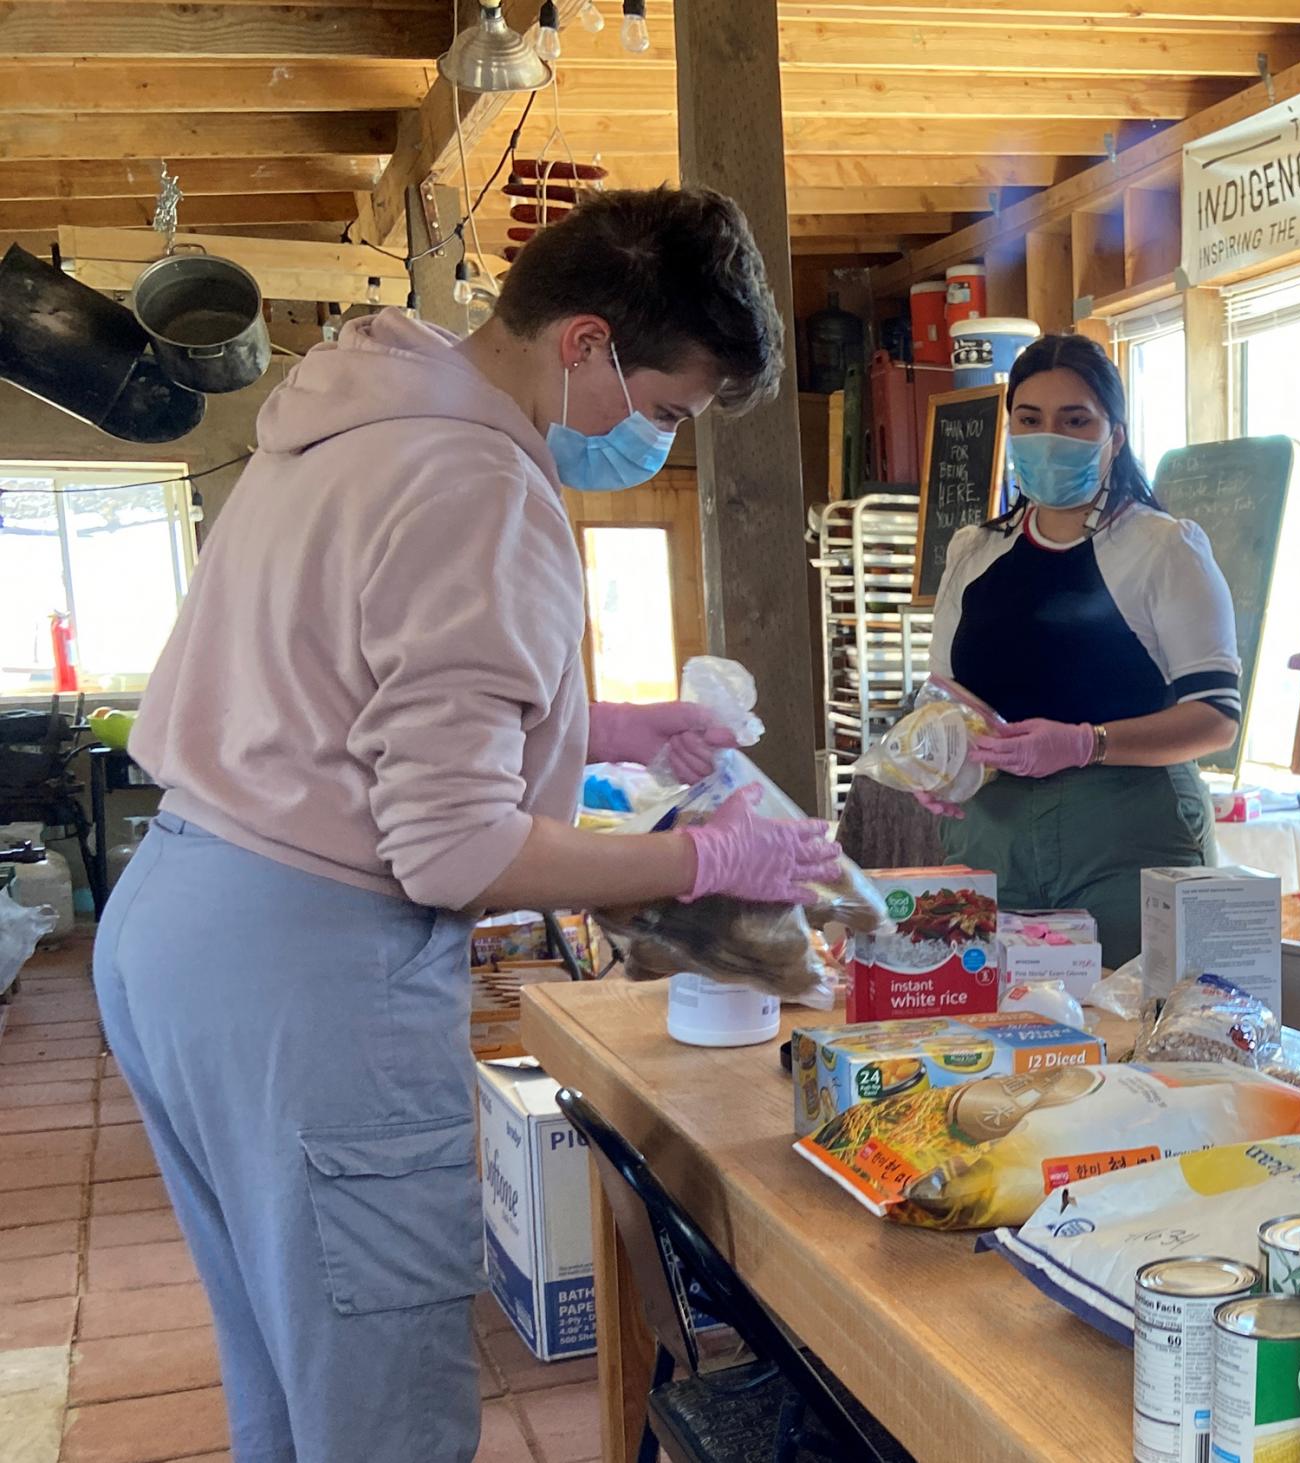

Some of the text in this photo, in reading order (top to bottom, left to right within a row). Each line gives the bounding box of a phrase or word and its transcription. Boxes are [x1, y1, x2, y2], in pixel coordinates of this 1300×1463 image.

[1200, 231, 1262, 269] INSPIRING
[1269, 217, 1296, 244] THE
[940, 417, 984, 439] THANK YOU
[951, 445, 968, 461] FOR
[939, 463, 968, 482] BEING
[939, 483, 980, 507] HERE.
[936, 508, 981, 528] YOU ARE
[891, 979, 934, 992] instant
[891, 989, 968, 1008] white rice
[1028, 1050, 1086, 1068] 12 Diced
[859, 1070, 881, 1085] 24
[558, 1287, 595, 1303] BATH
[559, 1302, 594, 1317] PAPE
[1156, 1302, 1182, 1314] Facts
[1167, 1335, 1182, 1347] 60
